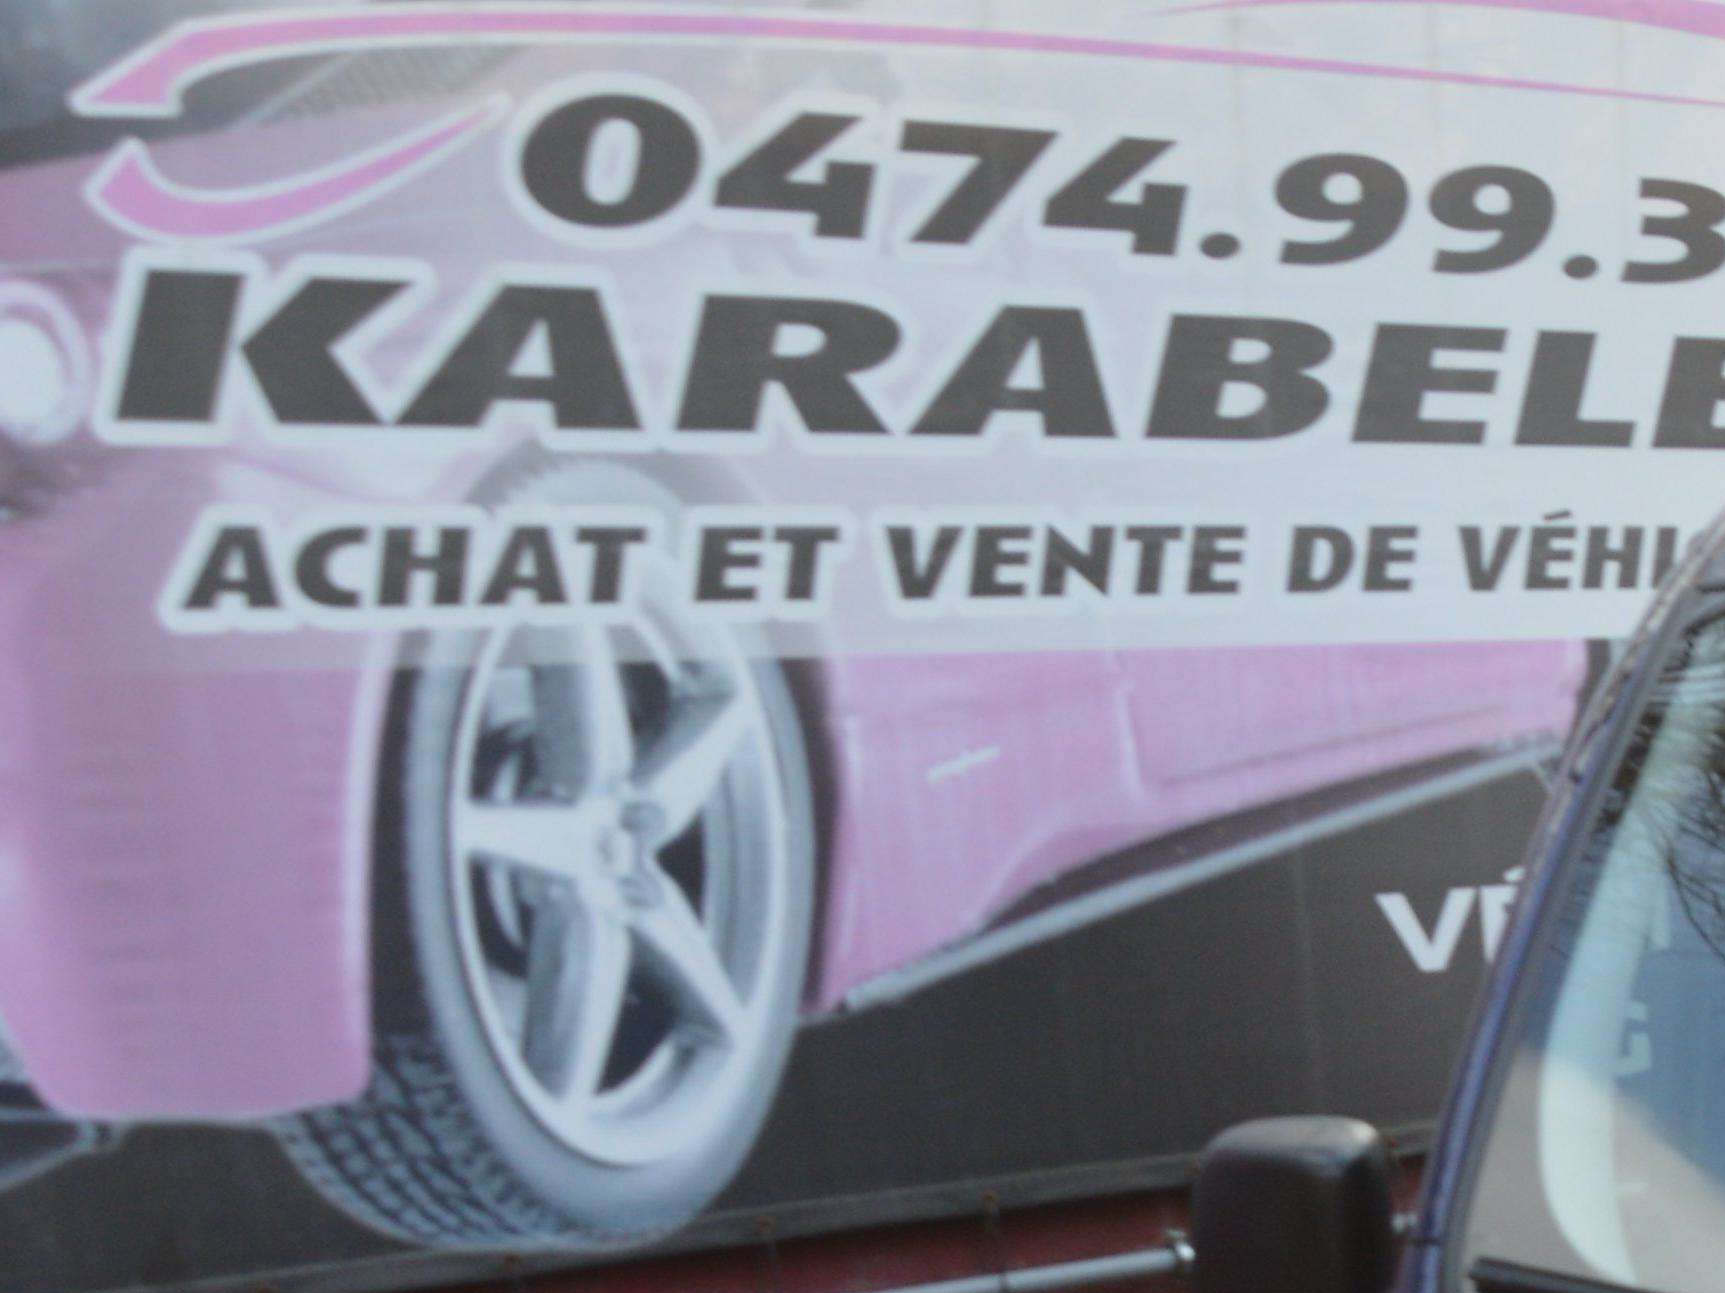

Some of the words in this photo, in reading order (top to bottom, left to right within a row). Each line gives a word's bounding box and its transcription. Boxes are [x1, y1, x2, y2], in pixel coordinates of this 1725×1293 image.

[183, 525, 647, 611] ACHAT
[695, 525, 841, 604] ET
[884, 525, 1249, 600] VENTE
[1285, 525, 1419, 594] DE
